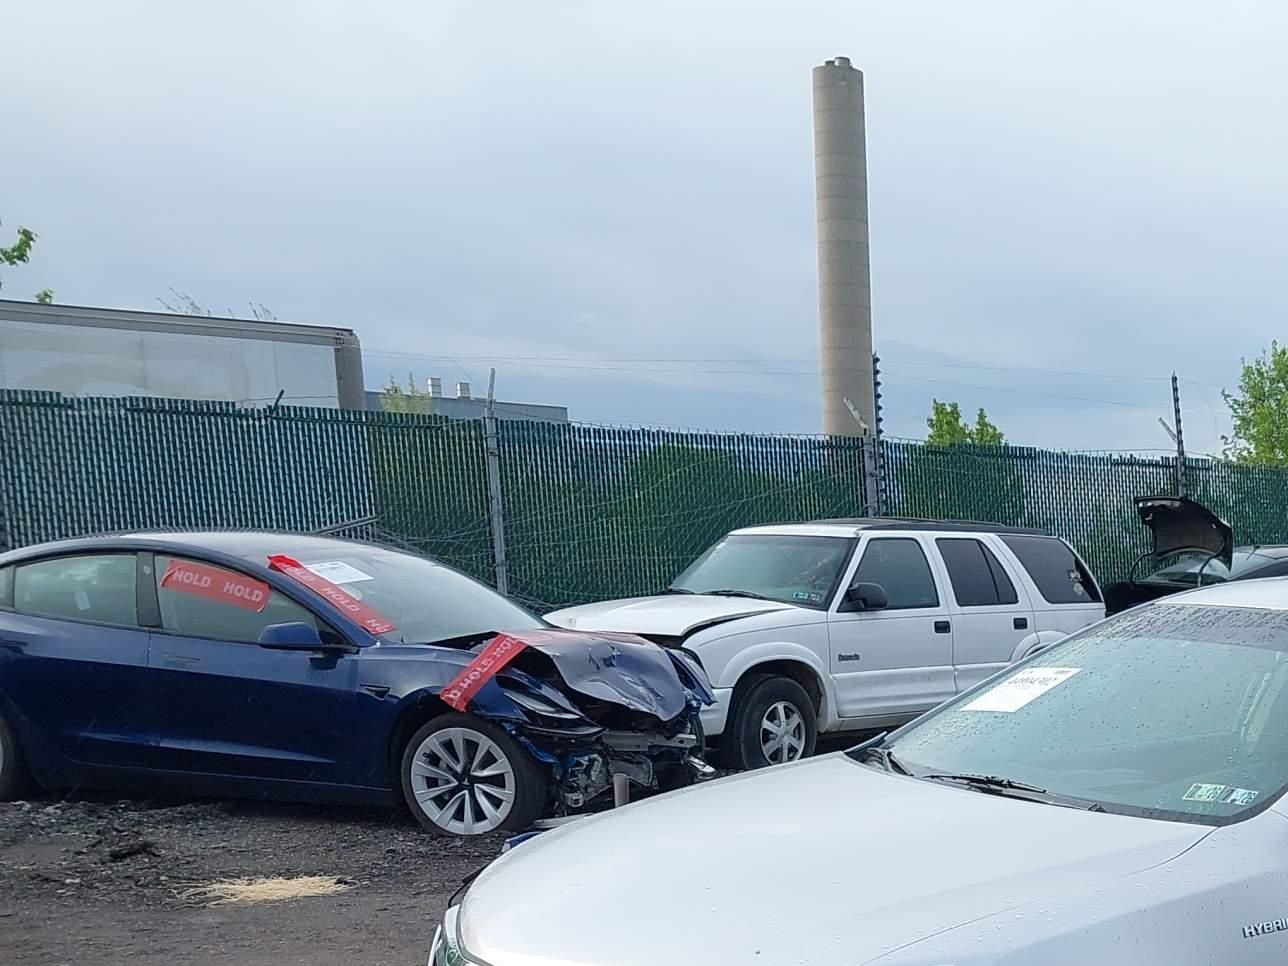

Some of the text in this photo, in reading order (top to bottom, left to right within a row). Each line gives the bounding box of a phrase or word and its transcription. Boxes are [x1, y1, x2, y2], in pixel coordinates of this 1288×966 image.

[172, 569, 263, 602] HOLD HOLD
[321, 587, 360, 612] HOLD
[459, 657, 495, 689] HOLD
